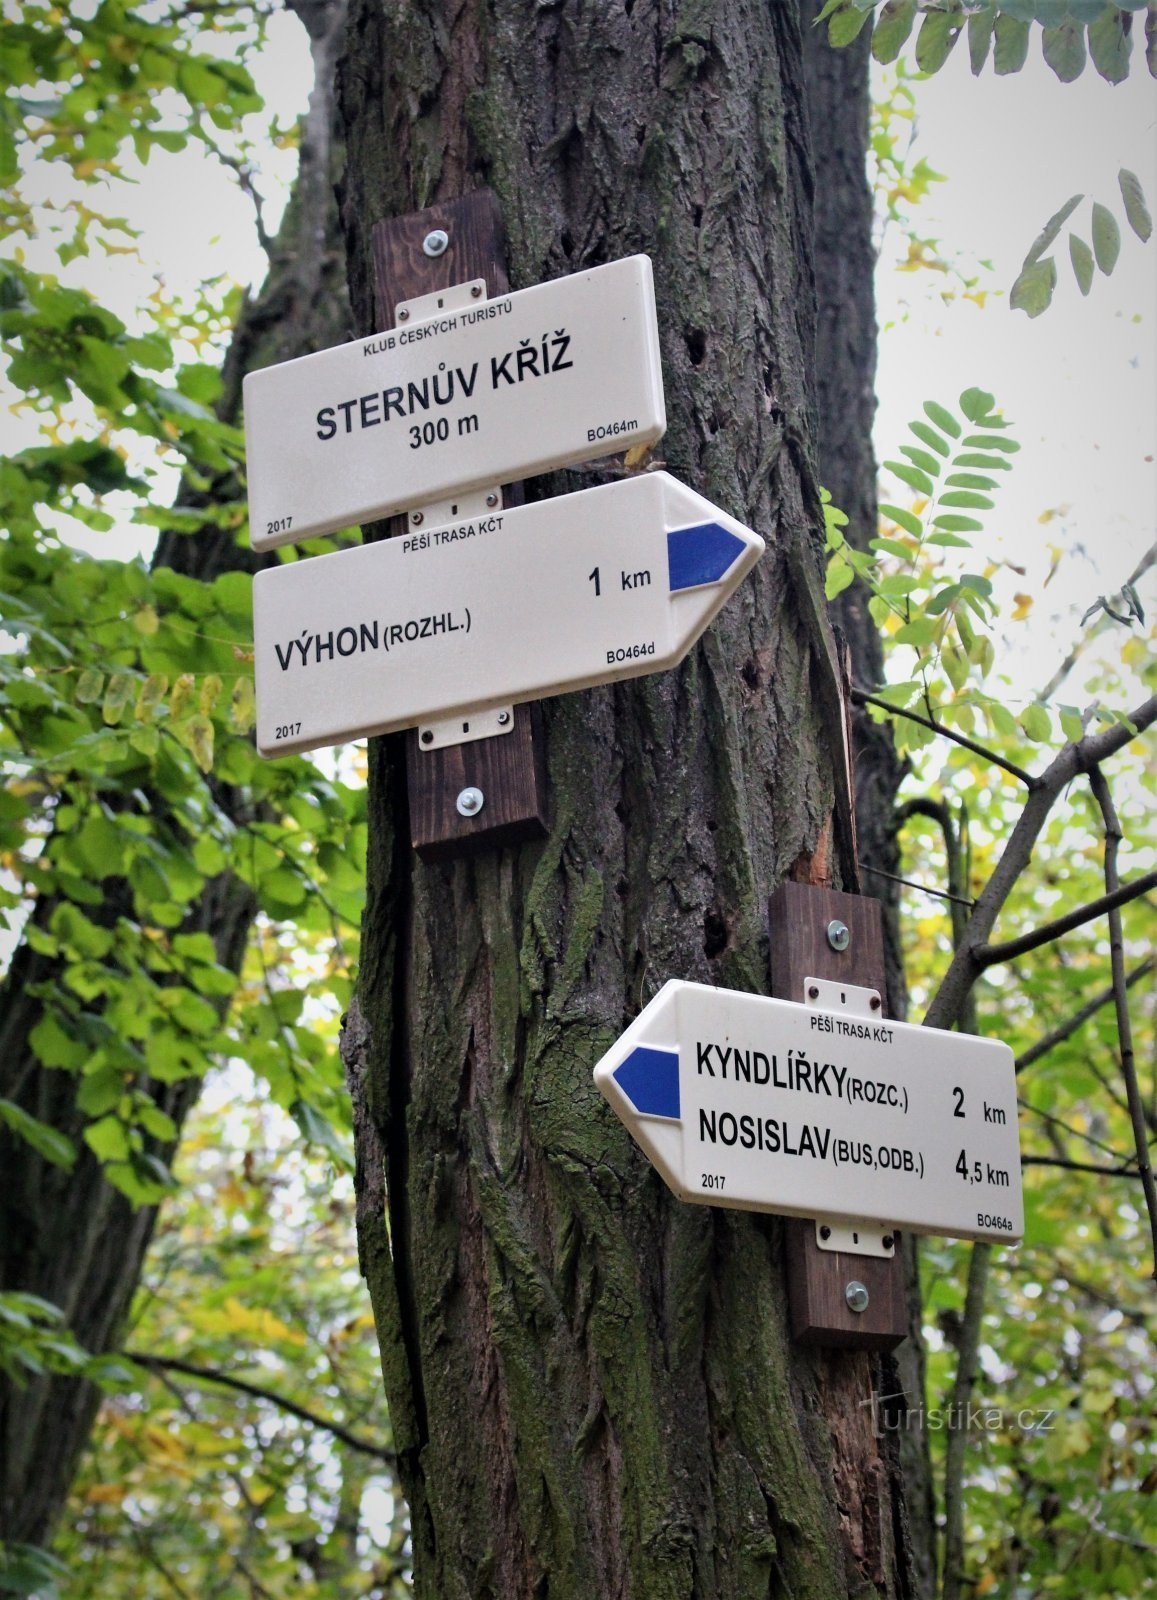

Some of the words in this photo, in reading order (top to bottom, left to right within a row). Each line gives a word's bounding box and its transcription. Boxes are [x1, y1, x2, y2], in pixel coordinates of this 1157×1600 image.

[364, 337, 396, 357] KLUB
[400, 319, 457, 346] ČESKÝCH
[460, 300, 513, 329] TURISTŮ
[316, 362, 478, 441] STERNŮV
[491, 329, 573, 390] KŘÍŽ
[409, 421, 449, 450] 300
[459, 414, 479, 436] m
[587, 418, 638, 441] BO464m
[267, 517, 293, 534] 2017
[403, 534, 430, 553] PĚŠÍ
[434, 526, 475, 545] TRASA
[478, 517, 504, 536] KČT
[589, 566, 601, 596] 1
[621, 569, 651, 590] km
[606, 642, 655, 664] BO464d
[275, 722, 302, 740] 2017
[810, 1016, 834, 1032] PĚŠÍ
[836, 1021, 871, 1040] TRASA
[873, 1027, 893, 1044] KČT
[953, 1086, 965, 1118] 2
[984, 1101, 1005, 1125] km
[701, 1174, 726, 1189] 2017
[955, 1149, 982, 1183] 4,5
[987, 1163, 1009, 1186] km
[977, 1214, 1012, 1231] BO464a
